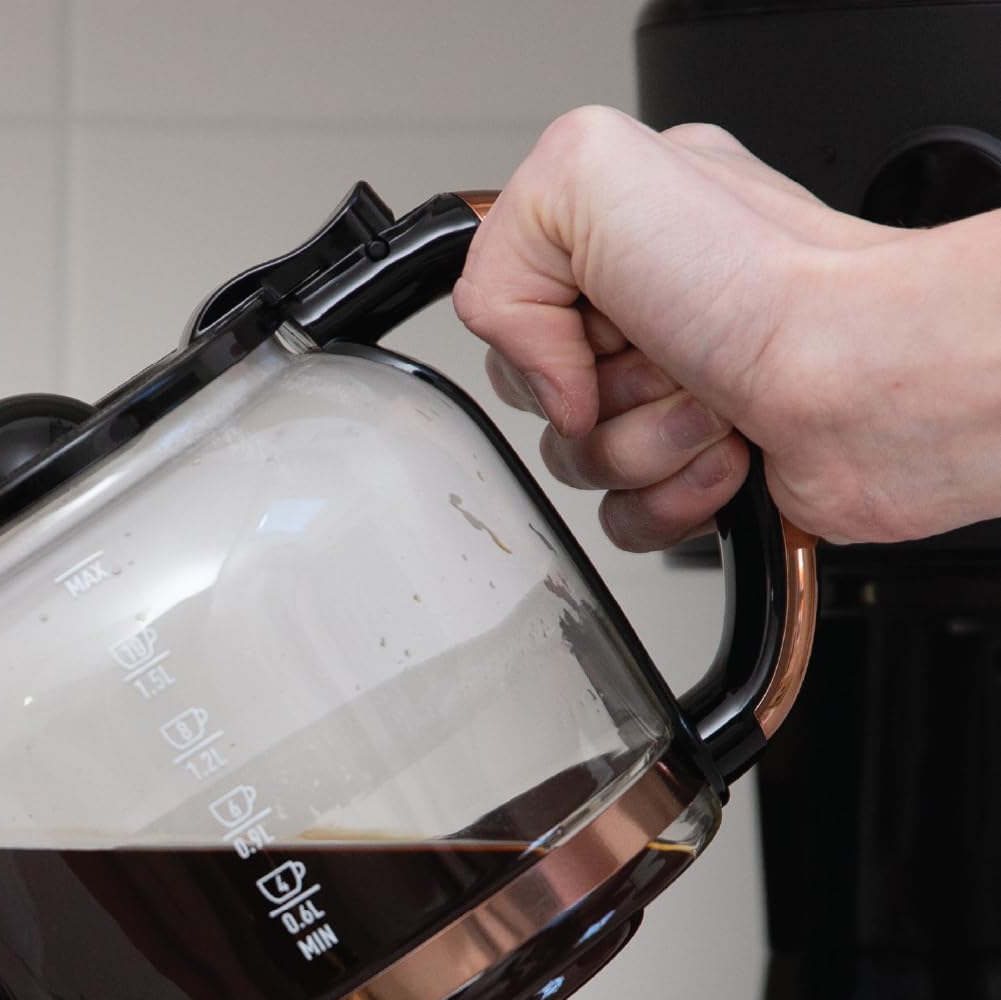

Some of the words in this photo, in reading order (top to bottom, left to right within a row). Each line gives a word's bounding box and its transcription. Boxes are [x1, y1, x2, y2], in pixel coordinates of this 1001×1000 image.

[64, 560, 107, 598] MAX
[133, 664, 176, 698] 1.5L
[175, 719, 193, 741] 8
[185, 746, 228, 780] 1.2L
[227, 798, 242, 819] 6
[233, 824, 276, 860] 0.9L
[273, 874, 291, 894] 4
[281, 899, 326, 935] 0.6L
[296, 922, 340, 962] MIN
